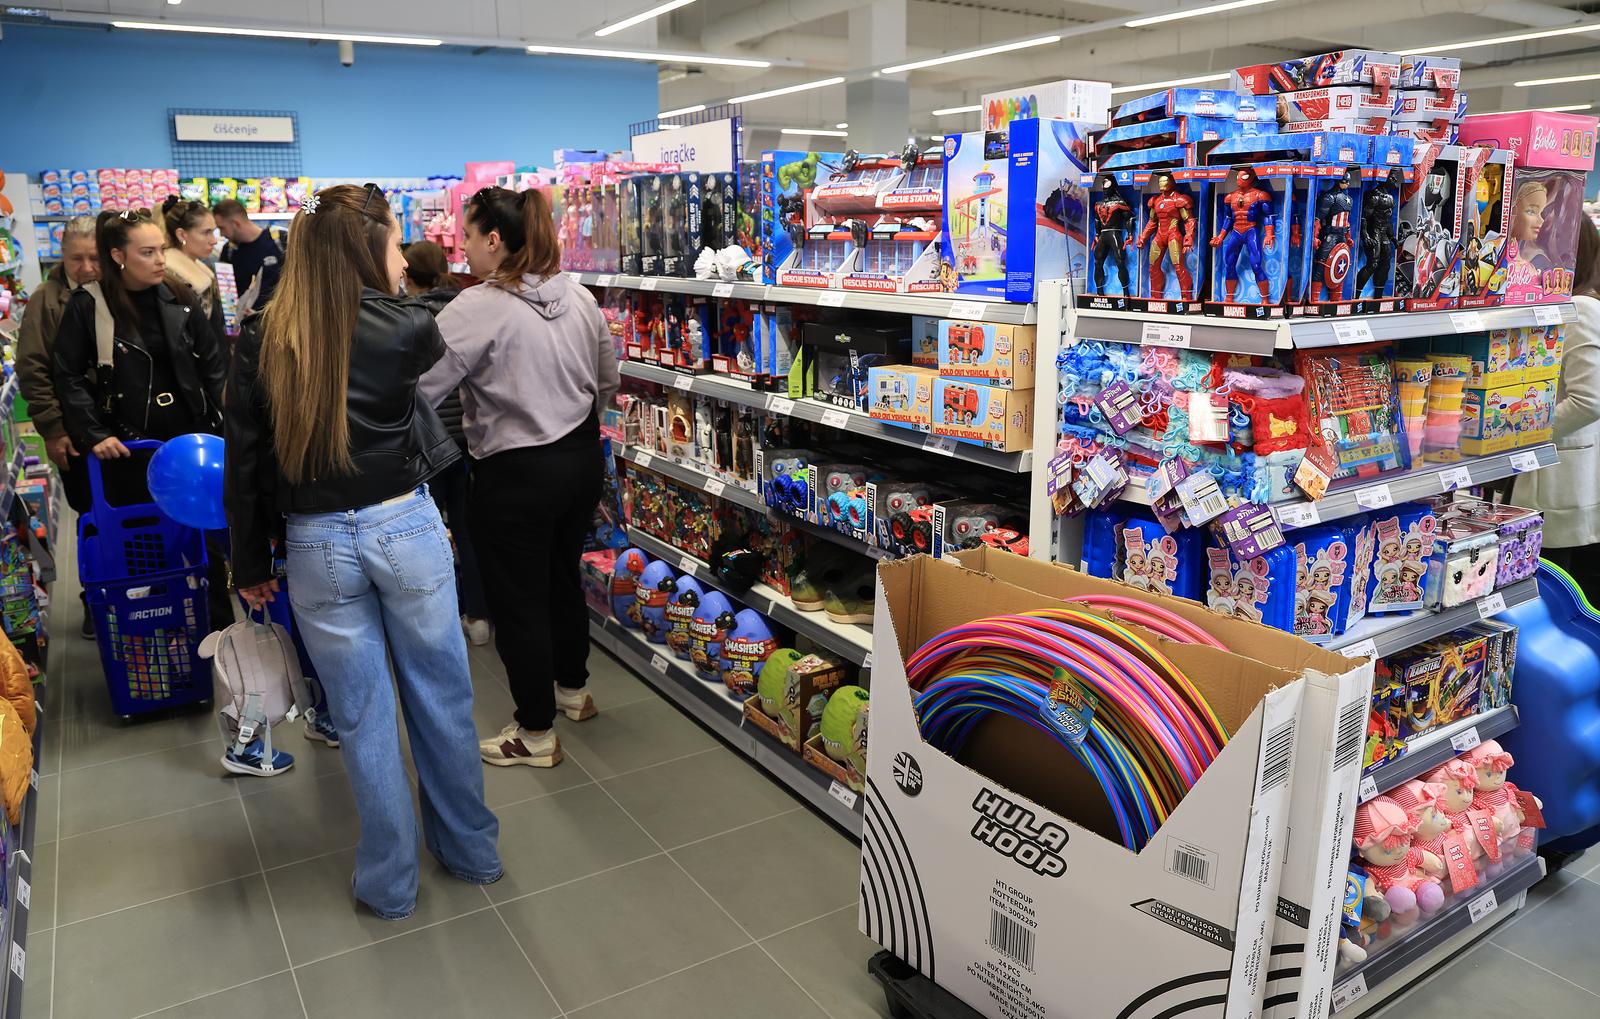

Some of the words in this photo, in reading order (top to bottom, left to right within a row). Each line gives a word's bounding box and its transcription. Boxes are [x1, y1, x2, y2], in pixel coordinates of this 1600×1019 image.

[1294, 90, 1329, 100] TRANSFORMERS
[1288, 121, 1322, 132] TRANSFORMERS
[1533, 126, 1558, 151] Barbie
[884, 194, 908, 204] RESCUE
[909, 194, 940, 202] STATION
[1454, 162, 1465, 239] TRANSFORMERS
[1501, 166, 1513, 239] TRANSFORMERS
[782, 274, 802, 283] RESCUE
[802, 276, 828, 285] STATION
[844, 278, 868, 288] RESCUE
[868, 280, 896, 289] STATION
[1506, 261, 1532, 288] Barbie
[1148, 302, 1168, 313] MARVEL
[1224, 306, 1246, 318] MARVEL
[1336, 304, 1352, 316] MARVEL
[1380, 302, 1394, 312] MARVEL
[1170, 334, 1184, 342] 2.29
[940, 368, 952, 376] FOLD
[966, 368, 990, 377] VEHICLE
[1436, 368, 1459, 376] CLAY
[891, 414, 912, 422] VEHICLE
[936, 428, 948, 436] FOLD
[948, 428, 960, 436] OUT
[960, 430, 983, 438] VEHICLE
[935, 511, 944, 535] STUNT
[134, 606, 173, 620] ACTION
[724, 638, 765, 655] SMASHERS
[1410, 660, 1442, 678] TEAMSTERZ
[1058, 716, 1078, 734] HOOP
[1060, 711, 1082, 730] HULA
[908, 778, 916, 789] UK
[972, 786, 1070, 854] HULA
[970, 816, 1068, 878] HOOP
[996, 879, 1007, 891] HTI
[1008, 886, 1034, 904] GROUP
[992, 887, 1036, 918] ROTTERDAM
[1279, 900, 1296, 912] 00%
[990, 895, 1008, 912] ITEM:
[1008, 908, 1038, 929] 3002287
[1156, 902, 1175, 915] MADE
[1178, 911, 1197, 925] FROM
[1199, 921, 1220, 934] 100%
[1151, 906, 1186, 926] RECYCLED
[1188, 923, 1224, 943] MATERIAL
[998, 958, 1007, 968] 24
[1008, 966, 1020, 978] PCS
[966, 965, 976, 976] PO
[976, 973, 1006, 998] NUMBER:
[974, 962, 996, 982] OUTER
[996, 976, 1024, 1000] WEIGHT:
[1025, 996, 1046, 1014] 3.4KG
[986, 962, 1020, 987] 80X12X80
[1020, 984, 1032, 996] CM
[990, 990, 1008, 1008] MADE
[1010, 1004, 1018, 1014] IN
